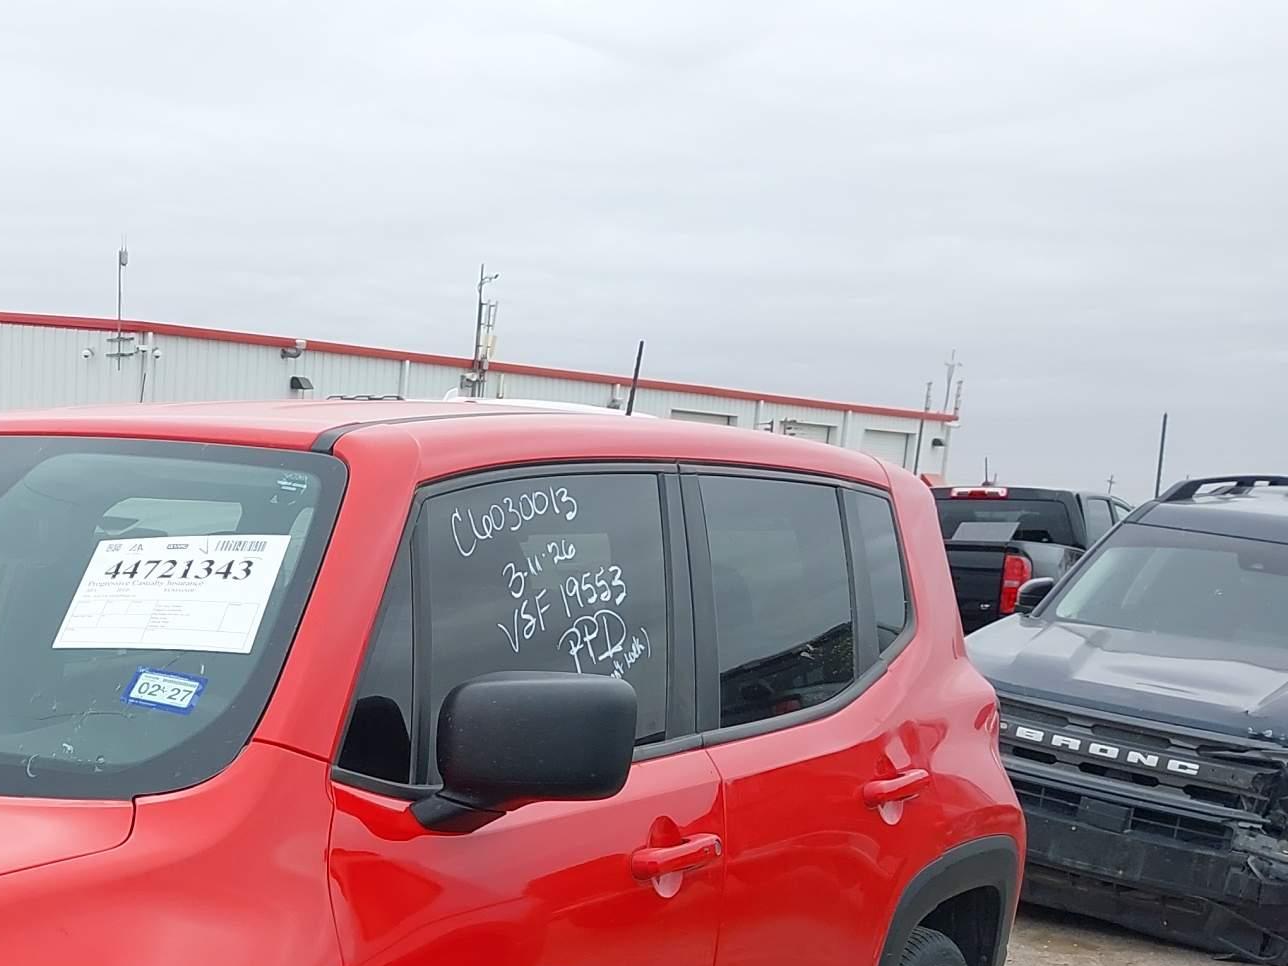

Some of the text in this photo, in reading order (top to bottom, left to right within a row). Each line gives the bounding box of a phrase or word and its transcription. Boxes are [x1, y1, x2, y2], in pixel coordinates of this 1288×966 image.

[104, 559, 254, 581] 44721343
[559, 565, 627, 618] 19553
[166, 687, 193, 702] 27
[1015, 726, 1200, 776] BRONC
